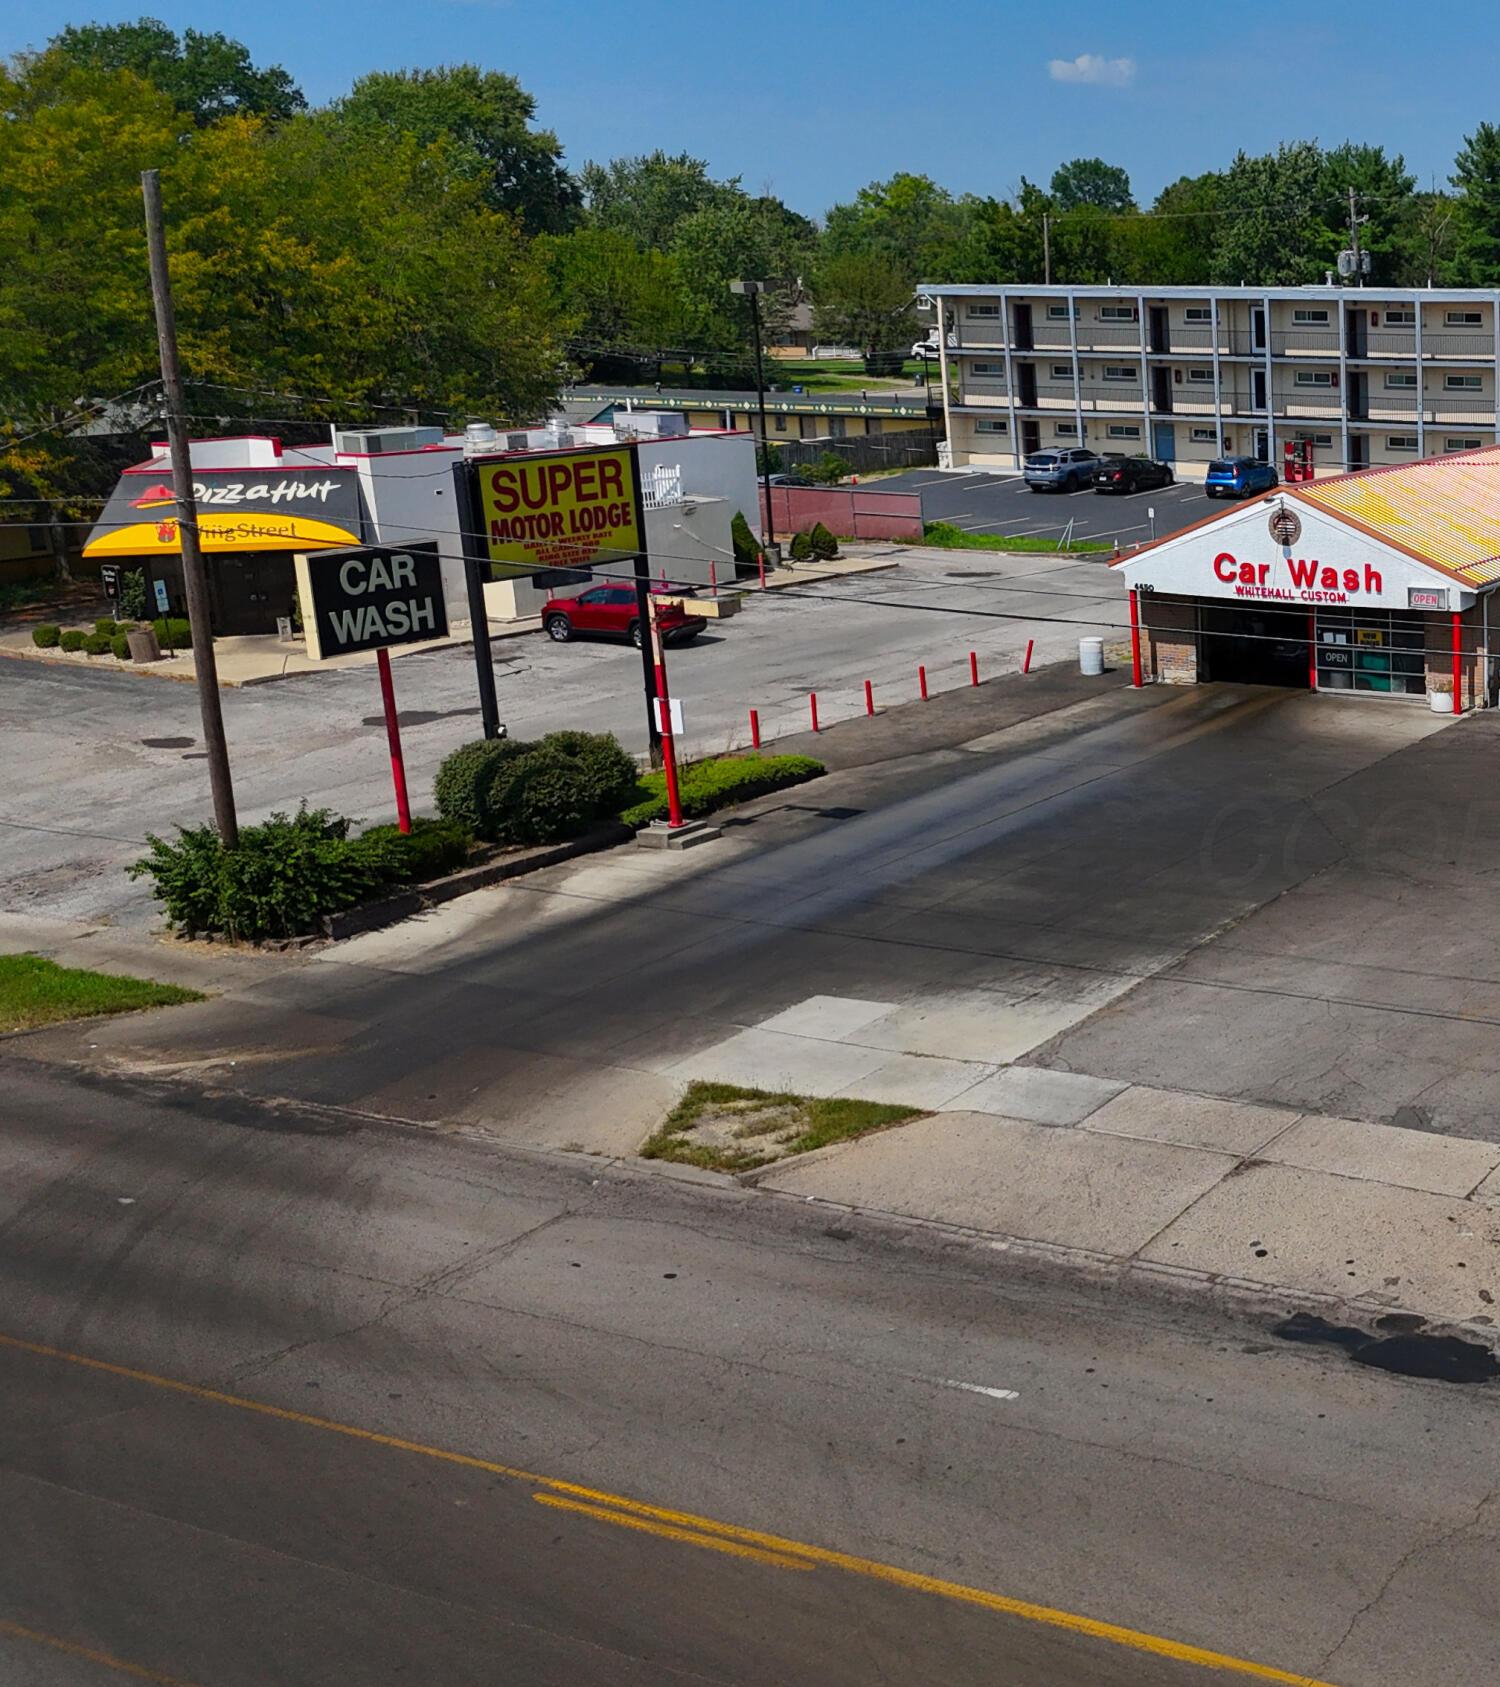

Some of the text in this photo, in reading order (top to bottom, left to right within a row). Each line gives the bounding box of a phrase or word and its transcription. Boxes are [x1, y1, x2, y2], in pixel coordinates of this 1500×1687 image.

[492, 459, 624, 513] SUPER
[491, 502, 632, 545] MOTOR LODGE
[340, 554, 417, 596] CAR
[1214, 552, 1383, 593] Car Wash
[1235, 585, 1347, 604] WHITEHALL CUSTOM
[1413, 594, 1437, 605] OPEN
[328, 597, 435, 645] WASH
[1325, 652, 1348, 663] OPEN
